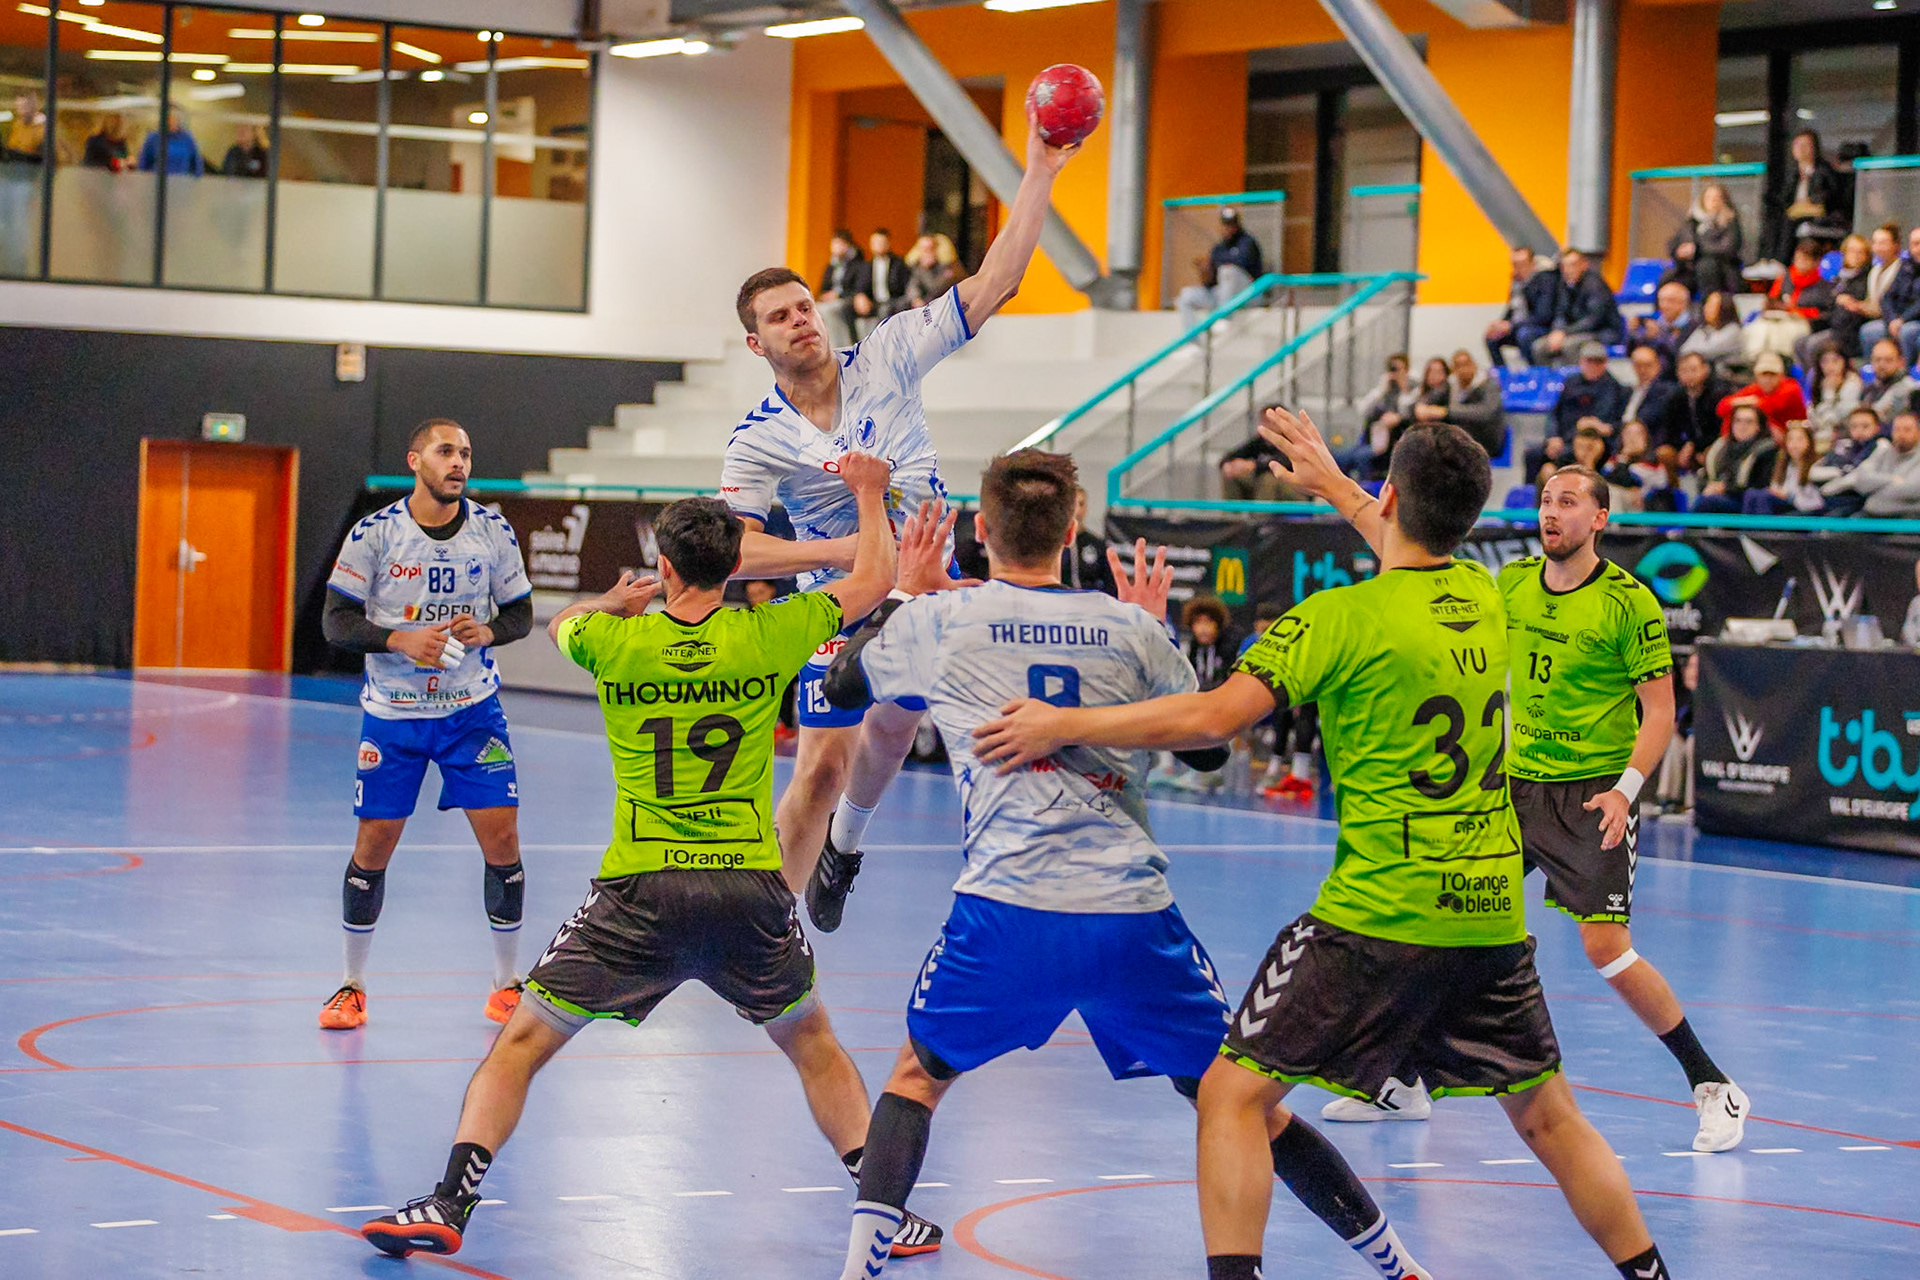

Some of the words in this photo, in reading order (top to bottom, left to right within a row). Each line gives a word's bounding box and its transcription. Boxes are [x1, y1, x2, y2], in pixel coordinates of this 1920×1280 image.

[390, 563, 422, 579] Orpi
[428, 566, 455, 594] 83
[1450, 647, 1487, 676] VU
[1528, 651, 1553, 684] 13
[391, 690, 417, 700] JEAN
[602, 672, 779, 705] THOUMINOT
[1514, 723, 1581, 741] roupama
[636, 713, 746, 798] 19
[664, 849, 745, 869] l'Orange
[1442, 873, 1509, 895] l'Orange
[1465, 895, 1512, 913] bleue
